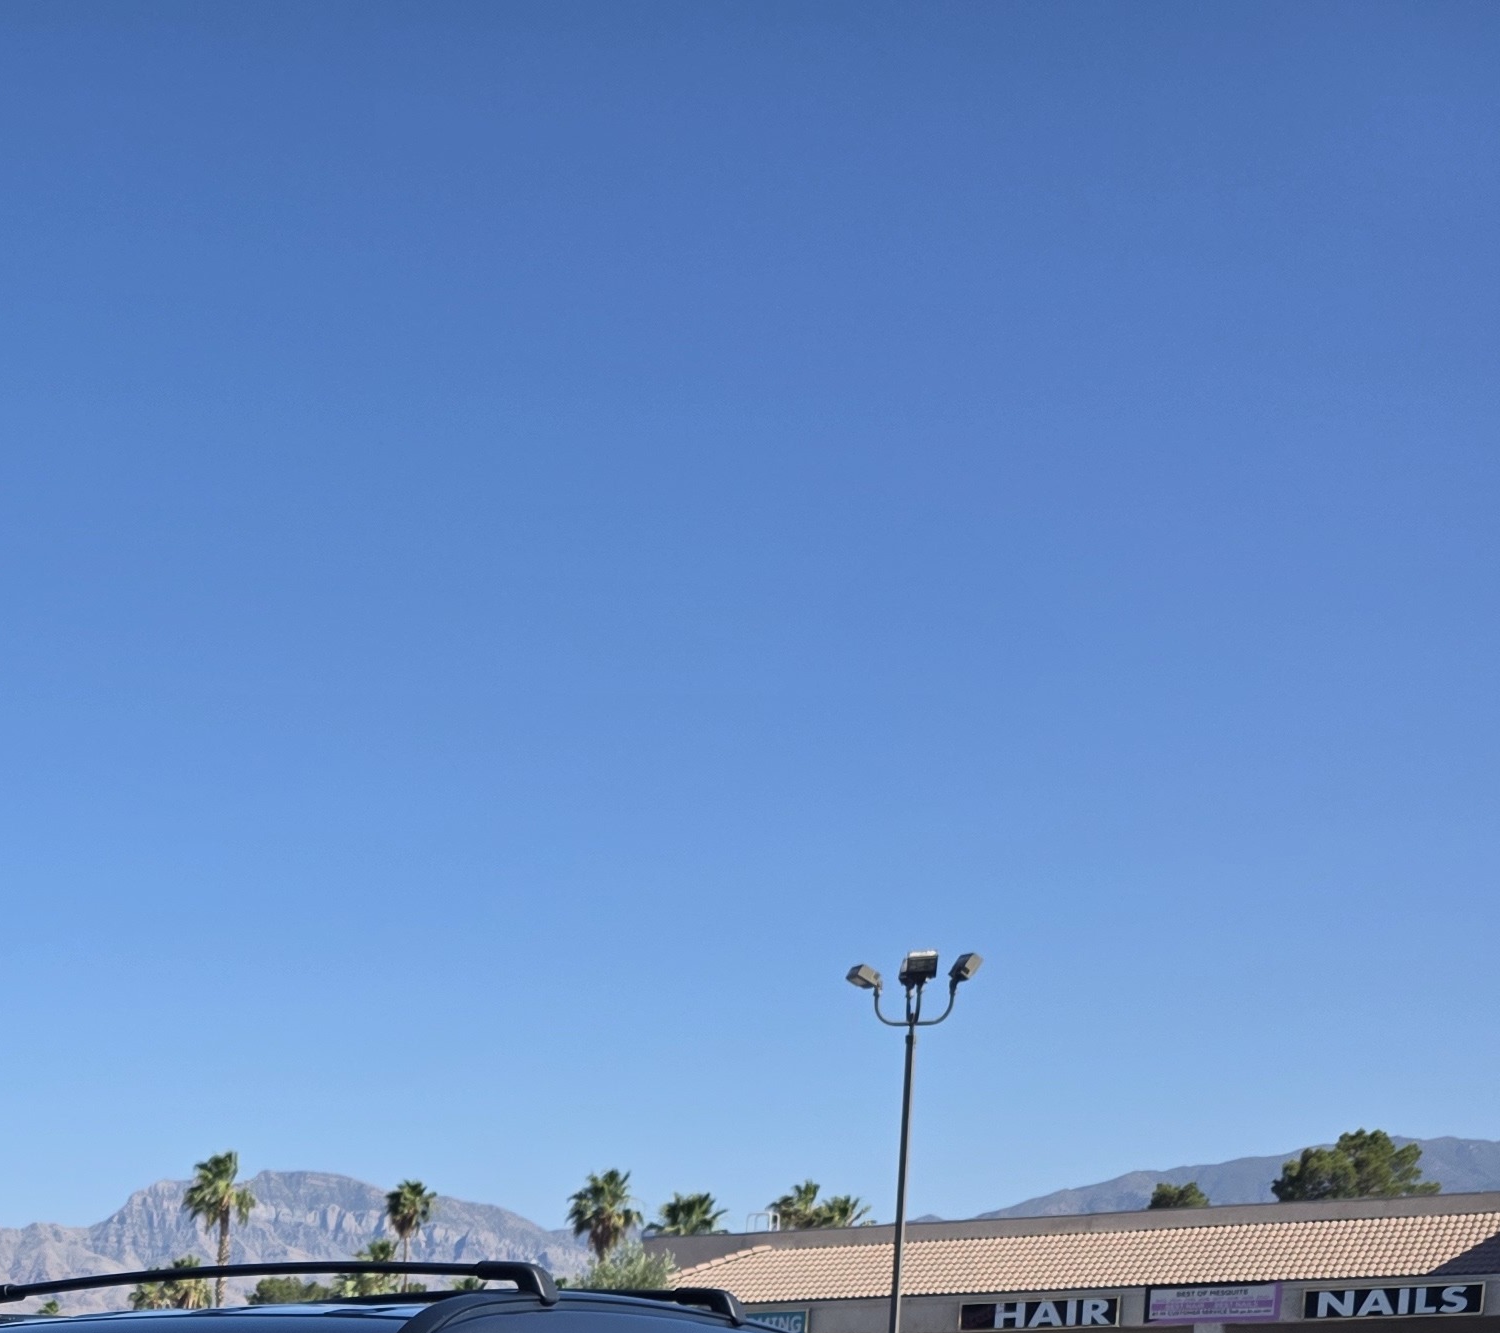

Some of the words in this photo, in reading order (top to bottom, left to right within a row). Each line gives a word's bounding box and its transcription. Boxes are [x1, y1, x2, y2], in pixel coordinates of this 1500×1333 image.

[1209, 1288, 1249, 1297] MESQUITE
[1316, 1285, 1469, 1318] NAILS
[993, 1298, 1111, 1329] HAIR
